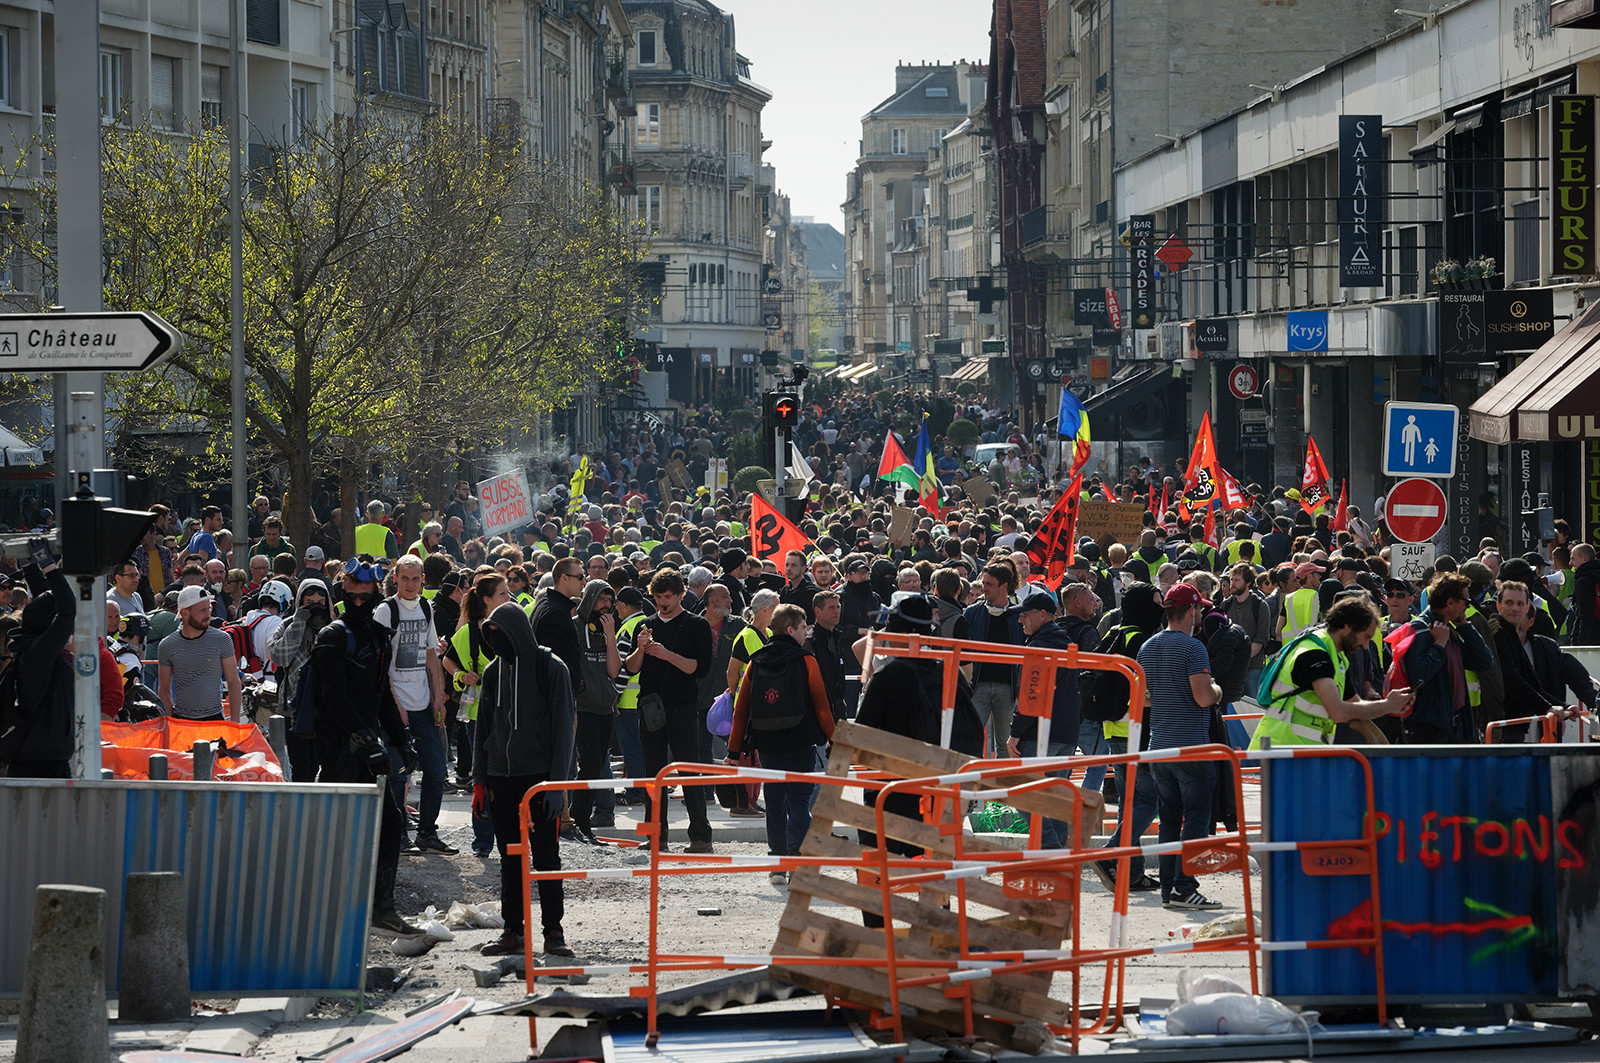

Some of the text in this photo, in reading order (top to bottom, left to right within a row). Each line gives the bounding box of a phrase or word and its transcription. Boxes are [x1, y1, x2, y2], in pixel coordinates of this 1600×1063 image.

[1557, 99, 1590, 271] FLEURS
[1132, 220, 1152, 229] BAR
[1136, 238, 1148, 309] ARCADES
[1106, 288, 1120, 329] TABAC
[28, 329, 116, 348] Château
[1196, 334, 1227, 342] Acuitis
[1290, 324, 1323, 340] Krys
[28, 350, 133, 360] de Guillaume le Conquérant
[1458, 414, 1470, 492] PRODUITS
[482, 474, 523, 509] SUISSE
[1521, 450, 1531, 548] RESTAUNT
[485, 496, 528, 528] NORMANDE
[1401, 546, 1426, 556] SAUF
[400, 634, 418, 644] LVER
[1028, 670, 1040, 701] COLAS
[1363, 810, 1584, 869] PIETONS
